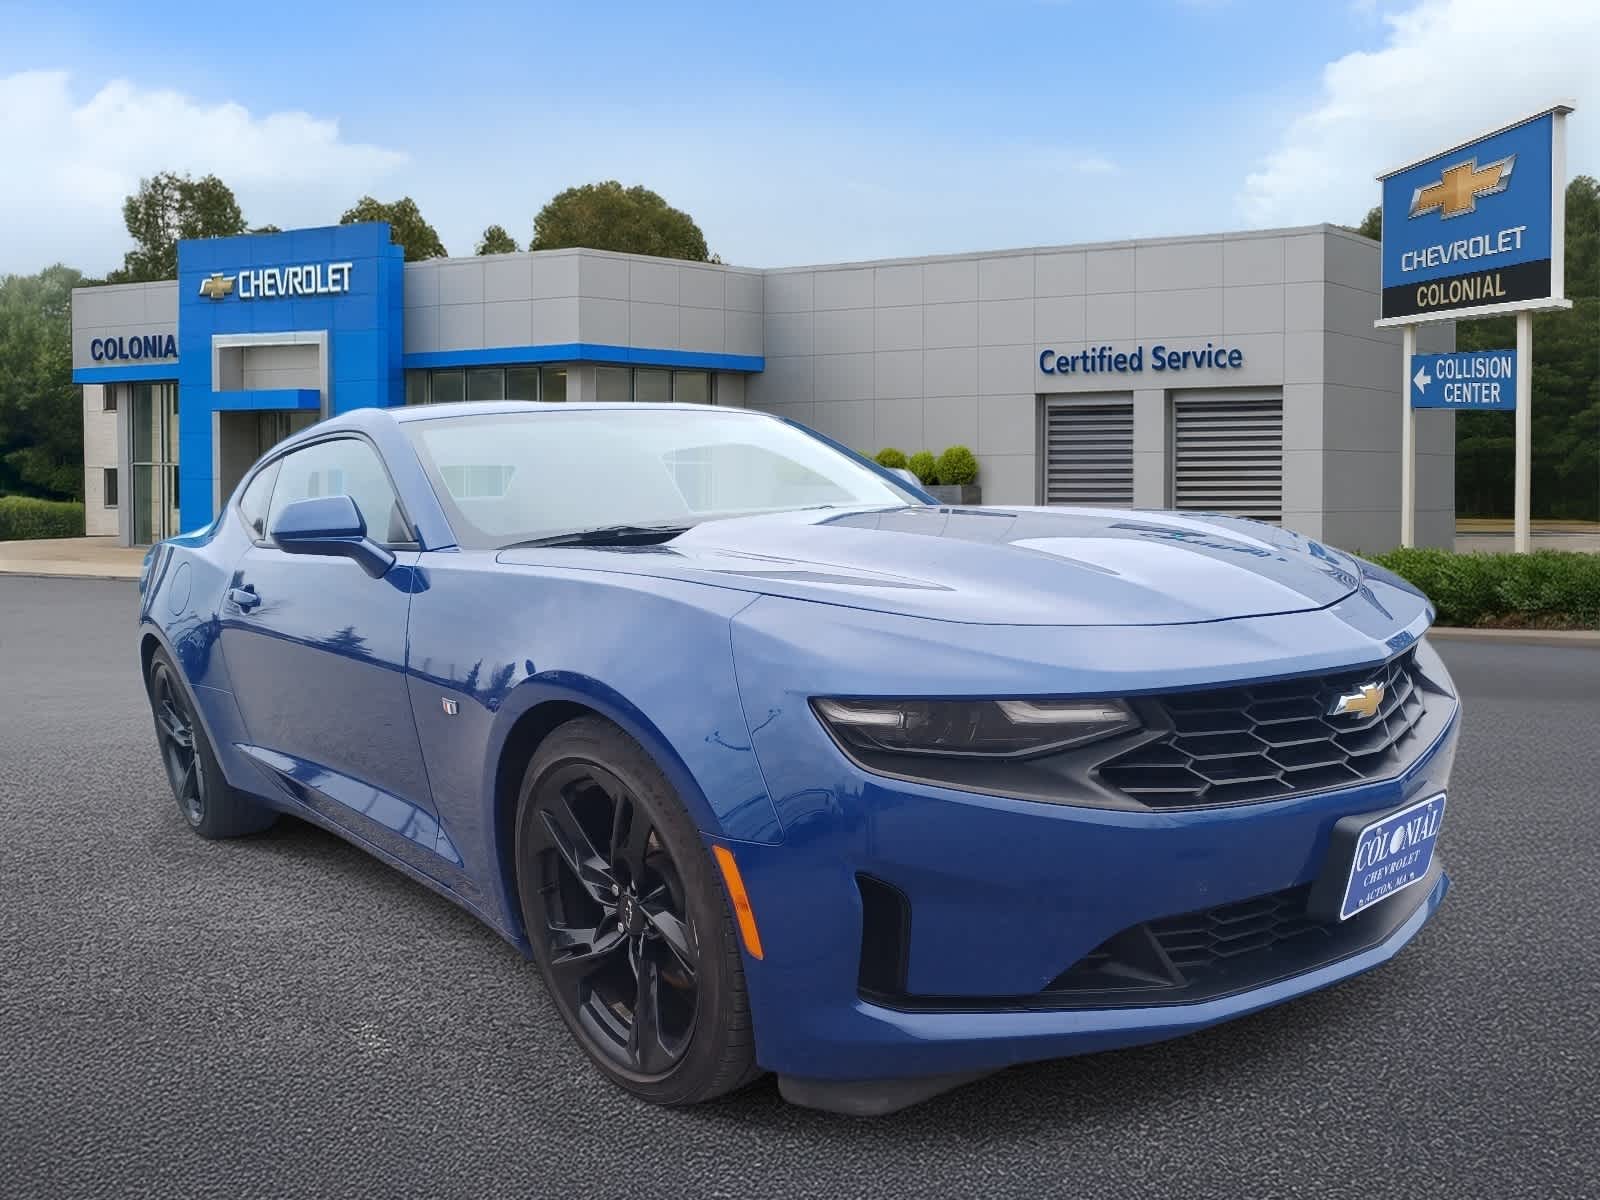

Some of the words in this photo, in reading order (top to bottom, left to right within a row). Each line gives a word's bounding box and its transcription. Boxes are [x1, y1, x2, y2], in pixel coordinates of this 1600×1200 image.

[1401, 225, 1528, 273] CHEVROLET
[239, 262, 353, 298] CHEVROLET
[1417, 274, 1506, 307] COLONIAL
[1039, 346, 1143, 374] Certified
[1151, 343, 1243, 370] Service
[1436, 357, 1511, 380] COLLISION
[1444, 383, 1501, 403] CENTER
[1357, 809, 1438, 871] COLONIAL
[1363, 849, 1420, 887] CHEVROLET
